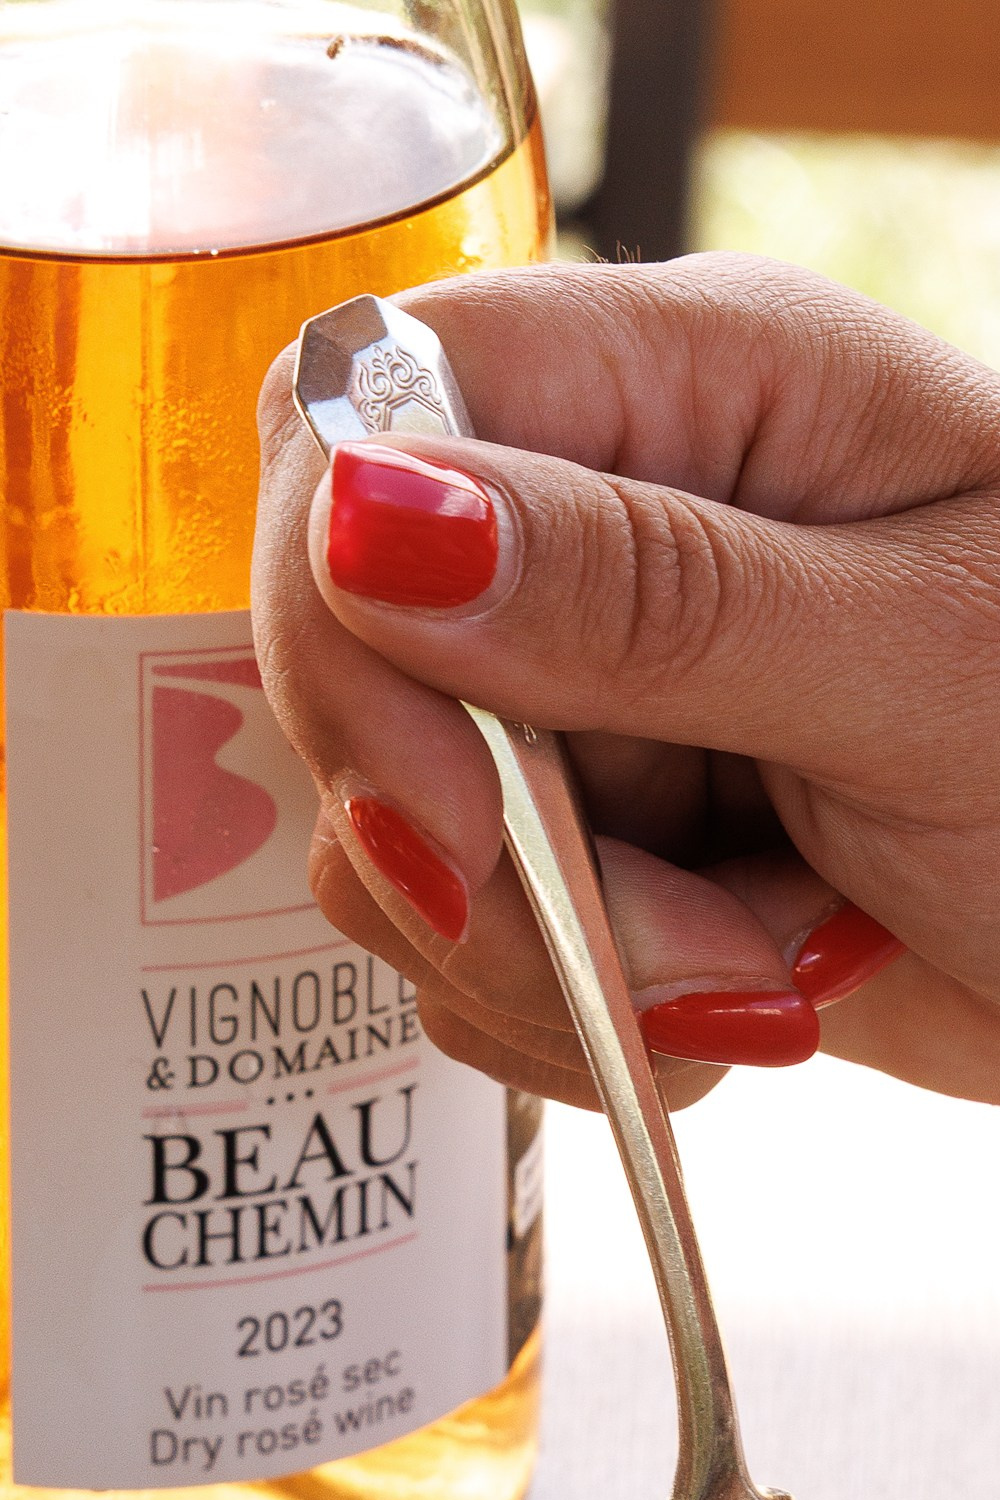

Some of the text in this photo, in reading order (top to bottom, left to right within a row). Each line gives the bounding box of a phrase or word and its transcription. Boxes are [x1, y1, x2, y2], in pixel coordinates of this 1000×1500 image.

[143, 1083, 420, 1206] BEAU
[141, 1162, 418, 1271] CHEMIN
[236, 1298, 345, 1358] 2023
[163, 1350, 402, 1421] Vin rosé sec
[150, 1387, 415, 1472] Dry rosé wine
